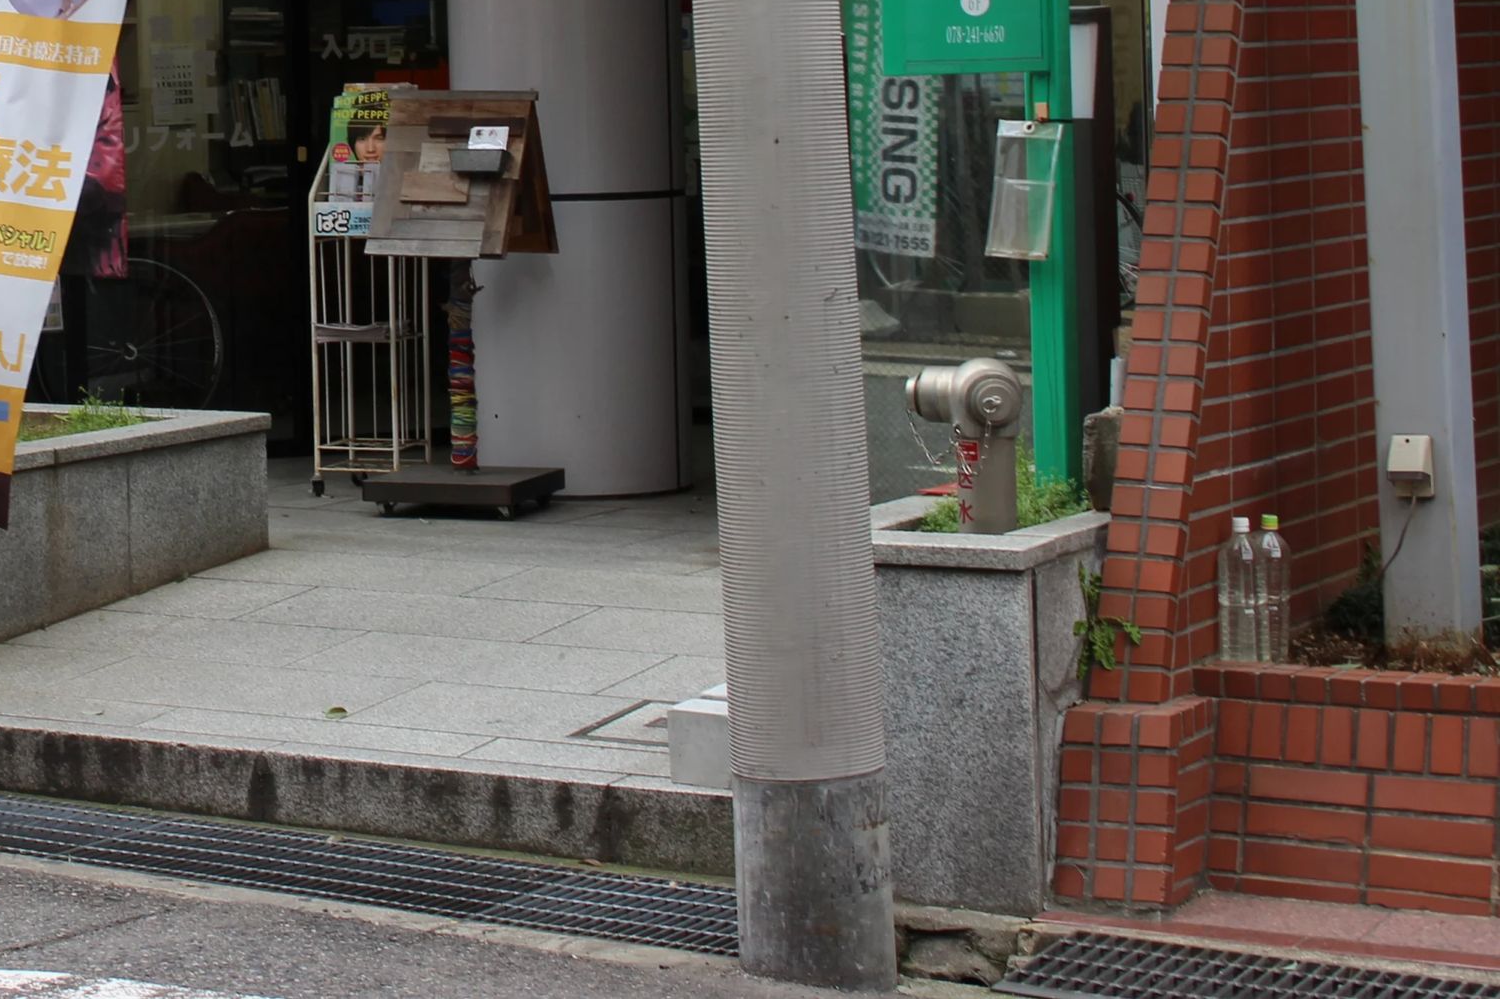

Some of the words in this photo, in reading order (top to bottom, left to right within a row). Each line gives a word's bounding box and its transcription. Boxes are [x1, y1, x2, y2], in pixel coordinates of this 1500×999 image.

[321, 32, 395, 62] 入り口
[945, 25, 1006, 44] 078-241-6650
[881, 76, 920, 205] SING
[316, 210, 350, 233] ぱど
